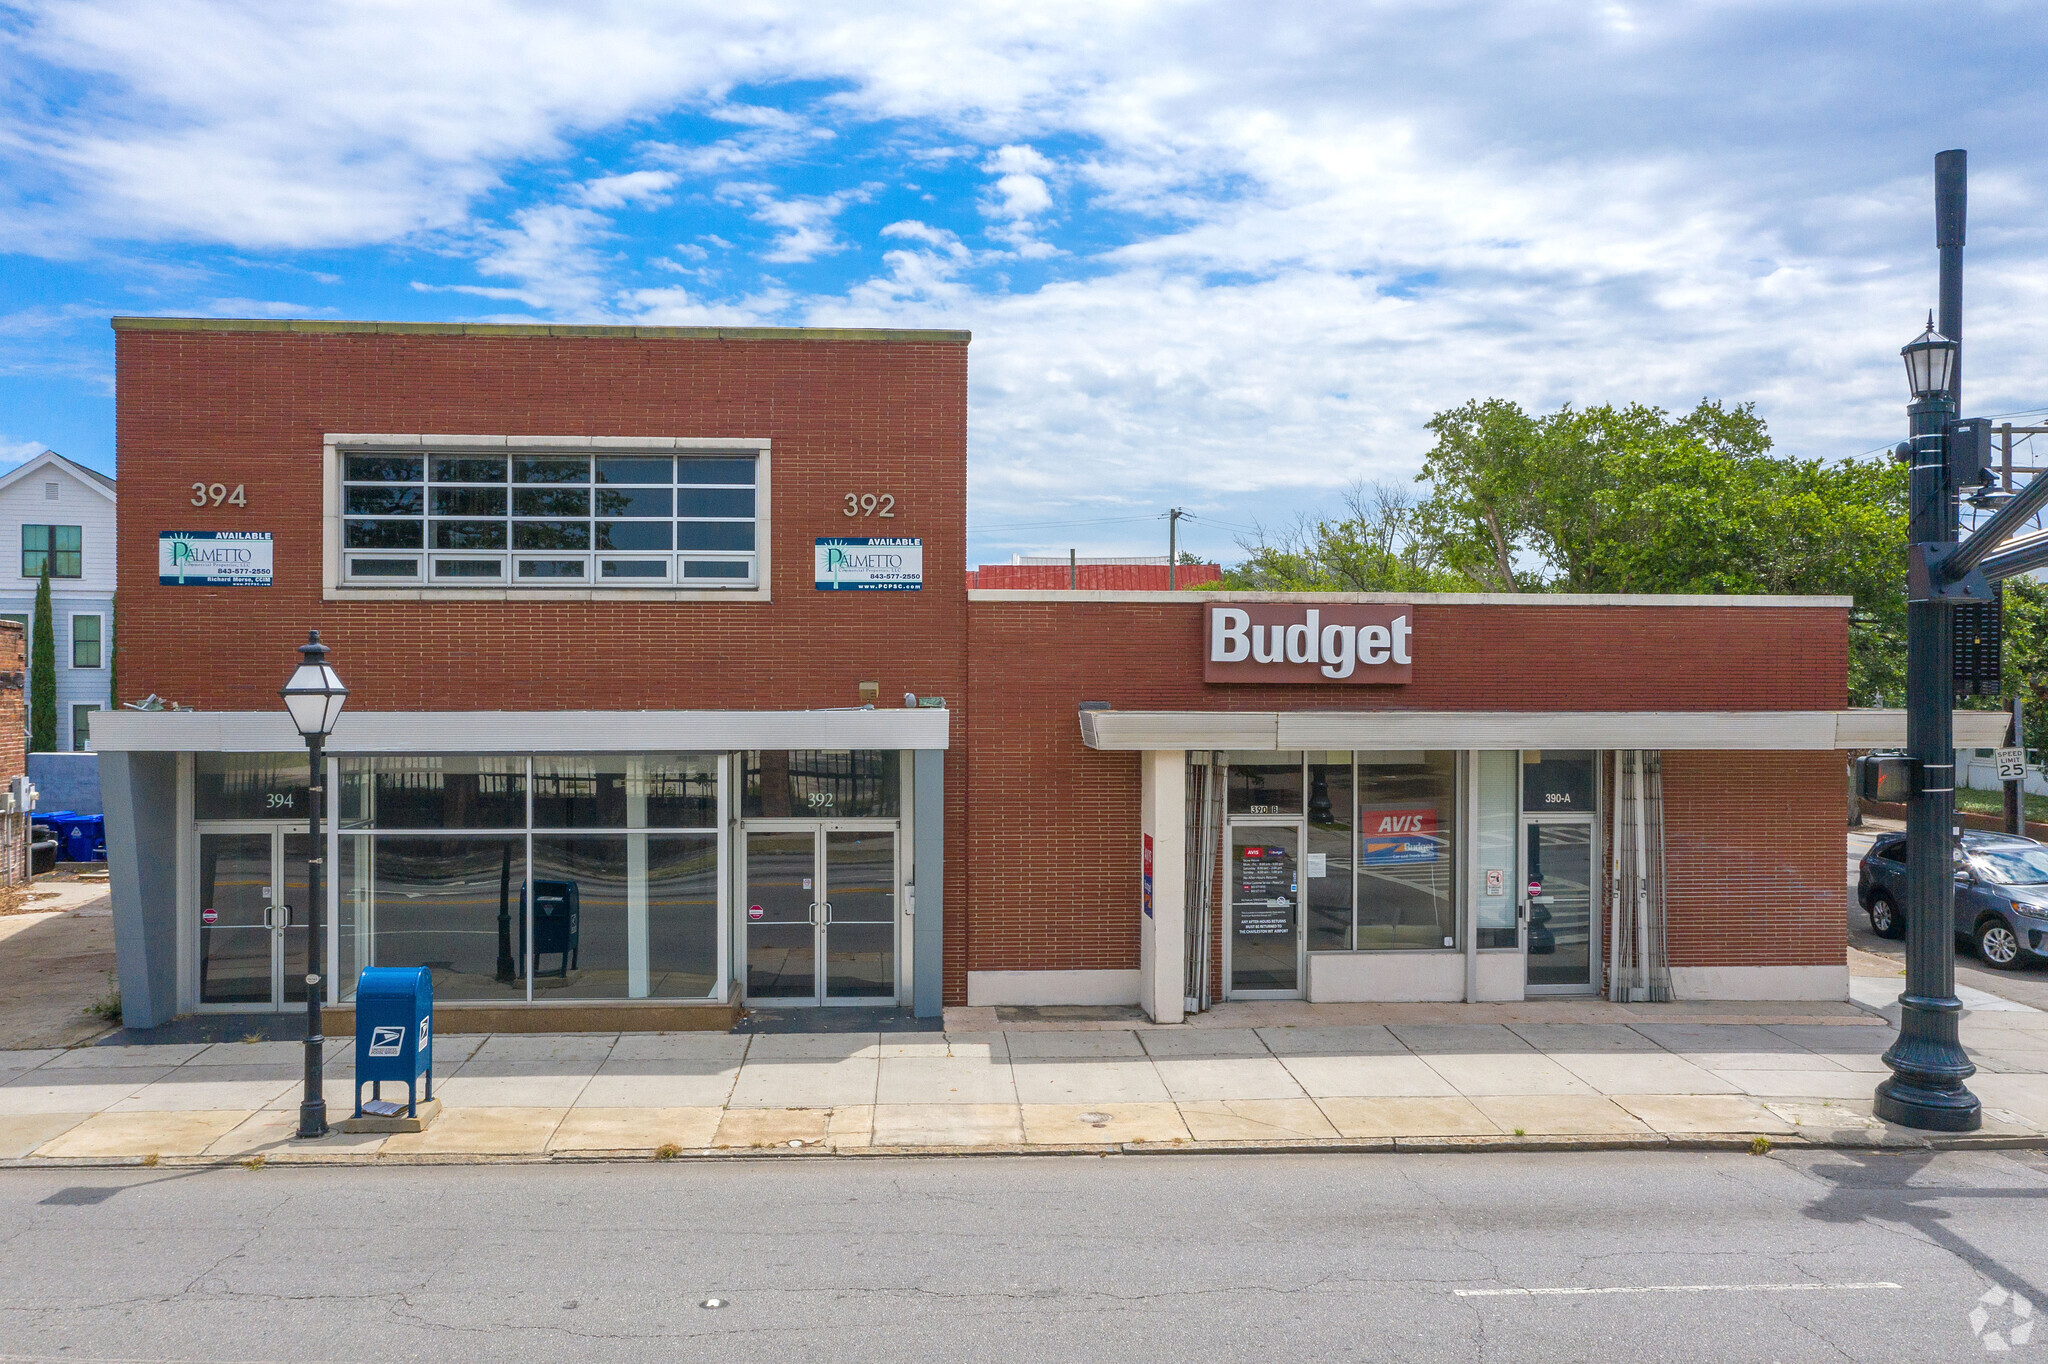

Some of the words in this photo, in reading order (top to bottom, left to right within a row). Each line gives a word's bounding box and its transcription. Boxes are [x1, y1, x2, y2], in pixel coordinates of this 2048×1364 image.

[190, 482, 248, 508] 394
[843, 492, 895, 518] 392
[215, 532, 272, 540] AVAILABLE
[867, 538, 921, 546] AVAILABLE
[172, 541, 252, 567] PALMETTO
[827, 548, 903, 573] PALMETTO
[1211, 607, 1412, 679] Budget
[1997, 750, 2023, 758] SPEED
[2000, 763, 2024, 777] 25
[266, 793, 294, 808] 394
[807, 792, 834, 808] 392
[1545, 793, 1571, 803] 390-A
[1377, 815, 1424, 833] AVIS
[1404, 842, 1434, 853] Budget
